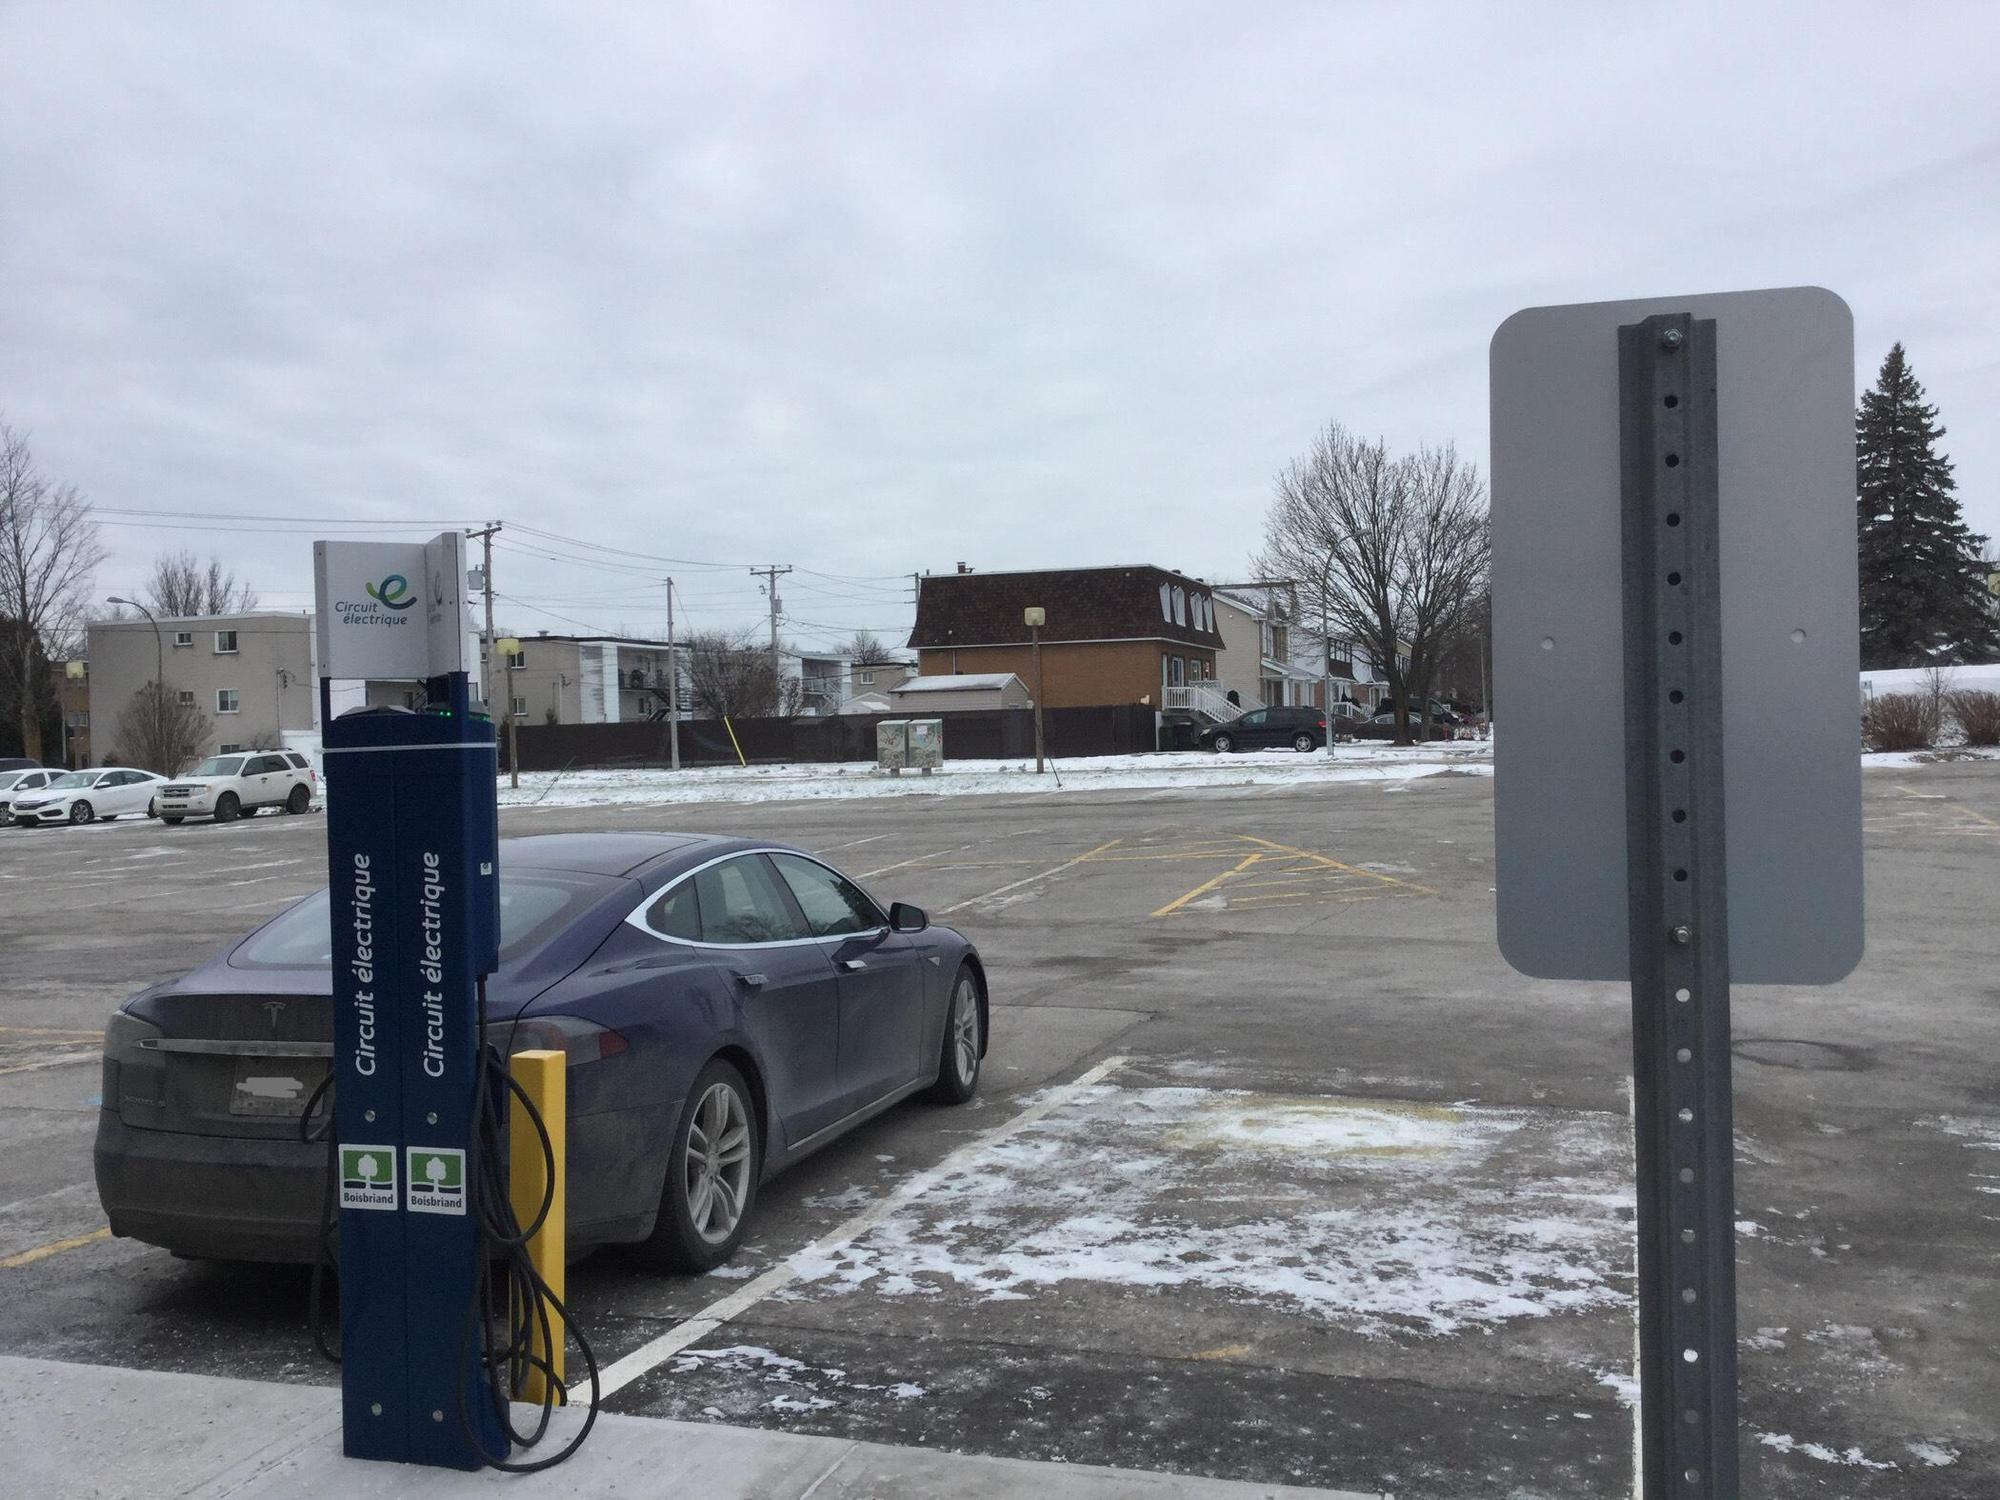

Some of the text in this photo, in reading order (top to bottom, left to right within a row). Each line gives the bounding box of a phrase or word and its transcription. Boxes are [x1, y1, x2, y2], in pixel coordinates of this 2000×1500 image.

[335, 601, 378, 613] Circuit
[343, 612, 408, 628] électrique
[351, 853, 376, 1076] Circuit électrique
[420, 851, 446, 1077] Circuit électrique
[343, 1192, 394, 1204] Boisbriand
[411, 1195, 462, 1208] Boisbriand
